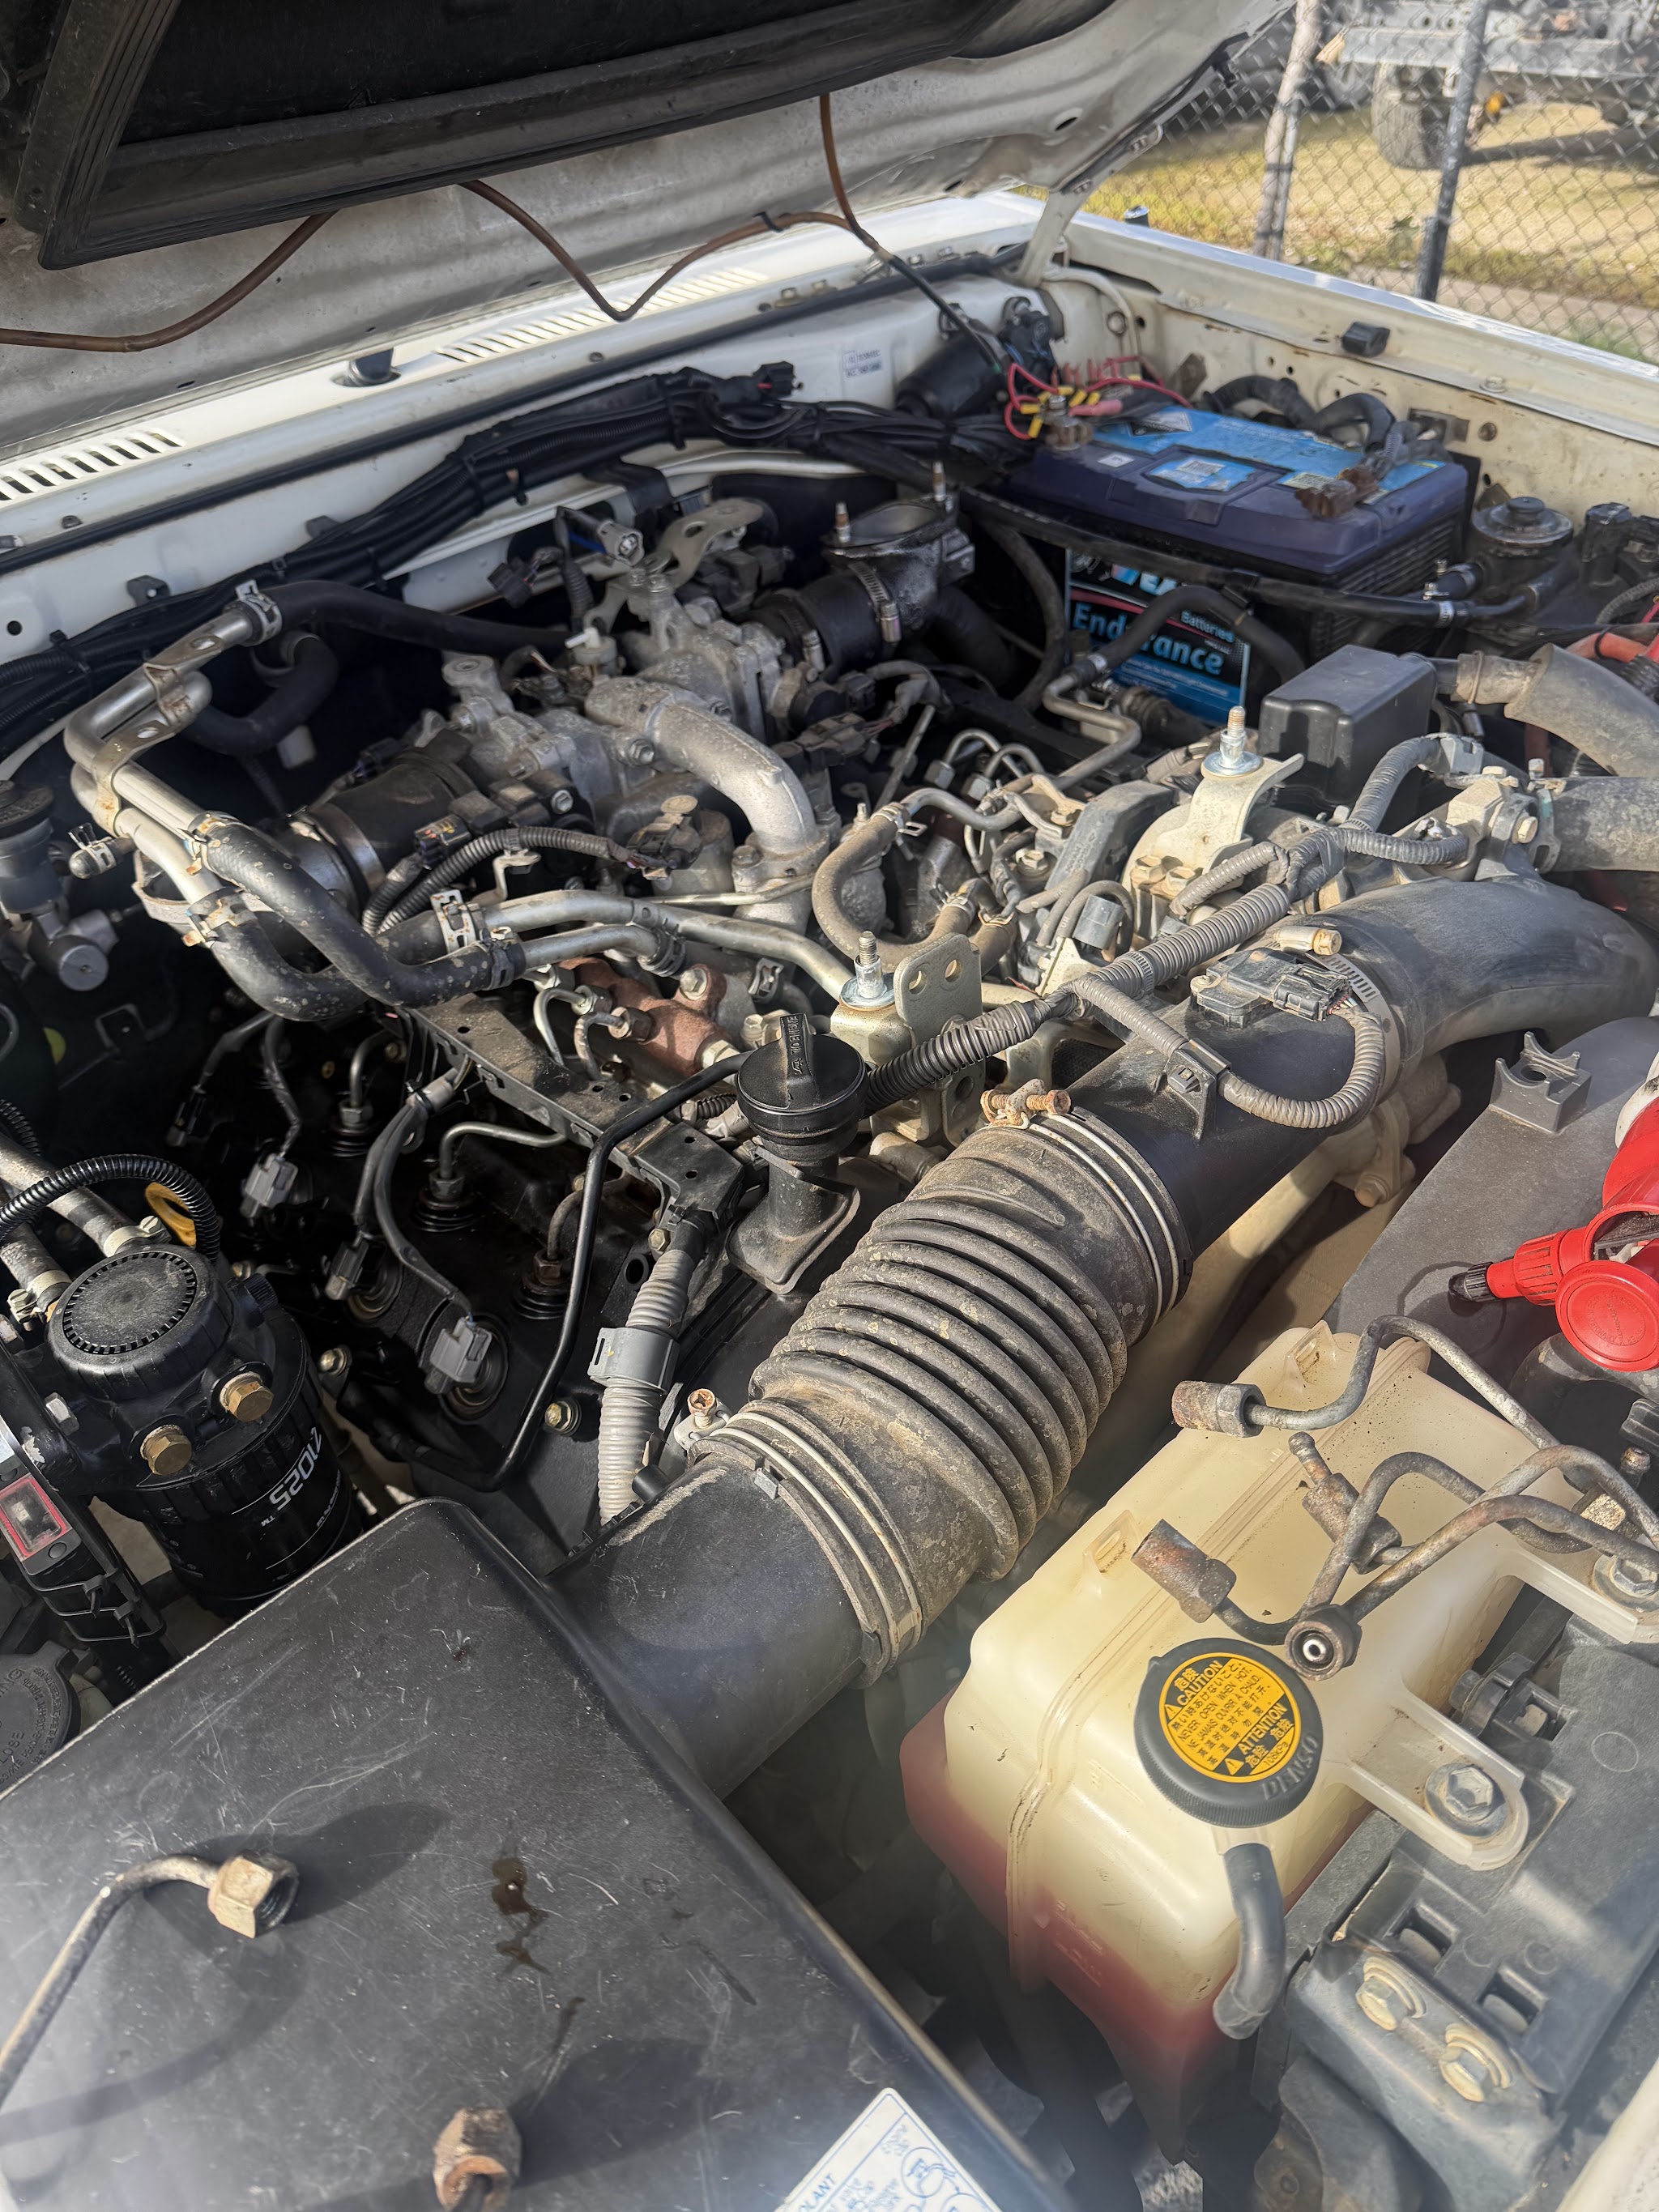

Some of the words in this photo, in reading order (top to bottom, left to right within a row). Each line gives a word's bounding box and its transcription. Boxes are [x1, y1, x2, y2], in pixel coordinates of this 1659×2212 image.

[1071, 602, 1225, 676] Endrance
[1180, 609, 1236, 644] Batteries
[787, 1016, 800, 1042] ENGINE
[790, 1042, 802, 1055] OIL
[1176, 1660, 1223, 1706] CAUTION
[1177, 1719, 1201, 1742] NEVER
[1199, 1700, 1218, 1720] OPEN
[1215, 1681, 1238, 1701] WHEN
[1187, 1738, 1200, 1750] NE
[1196, 1718, 1219, 1742] JAMAIS
[1215, 1698, 1238, 1721] OUVRIR
[1238, 1702, 1288, 1756] ATTENTION
[1262, 1732, 1320, 1801] DENSO
[1263, 1741, 1290, 1767] 108kPa
